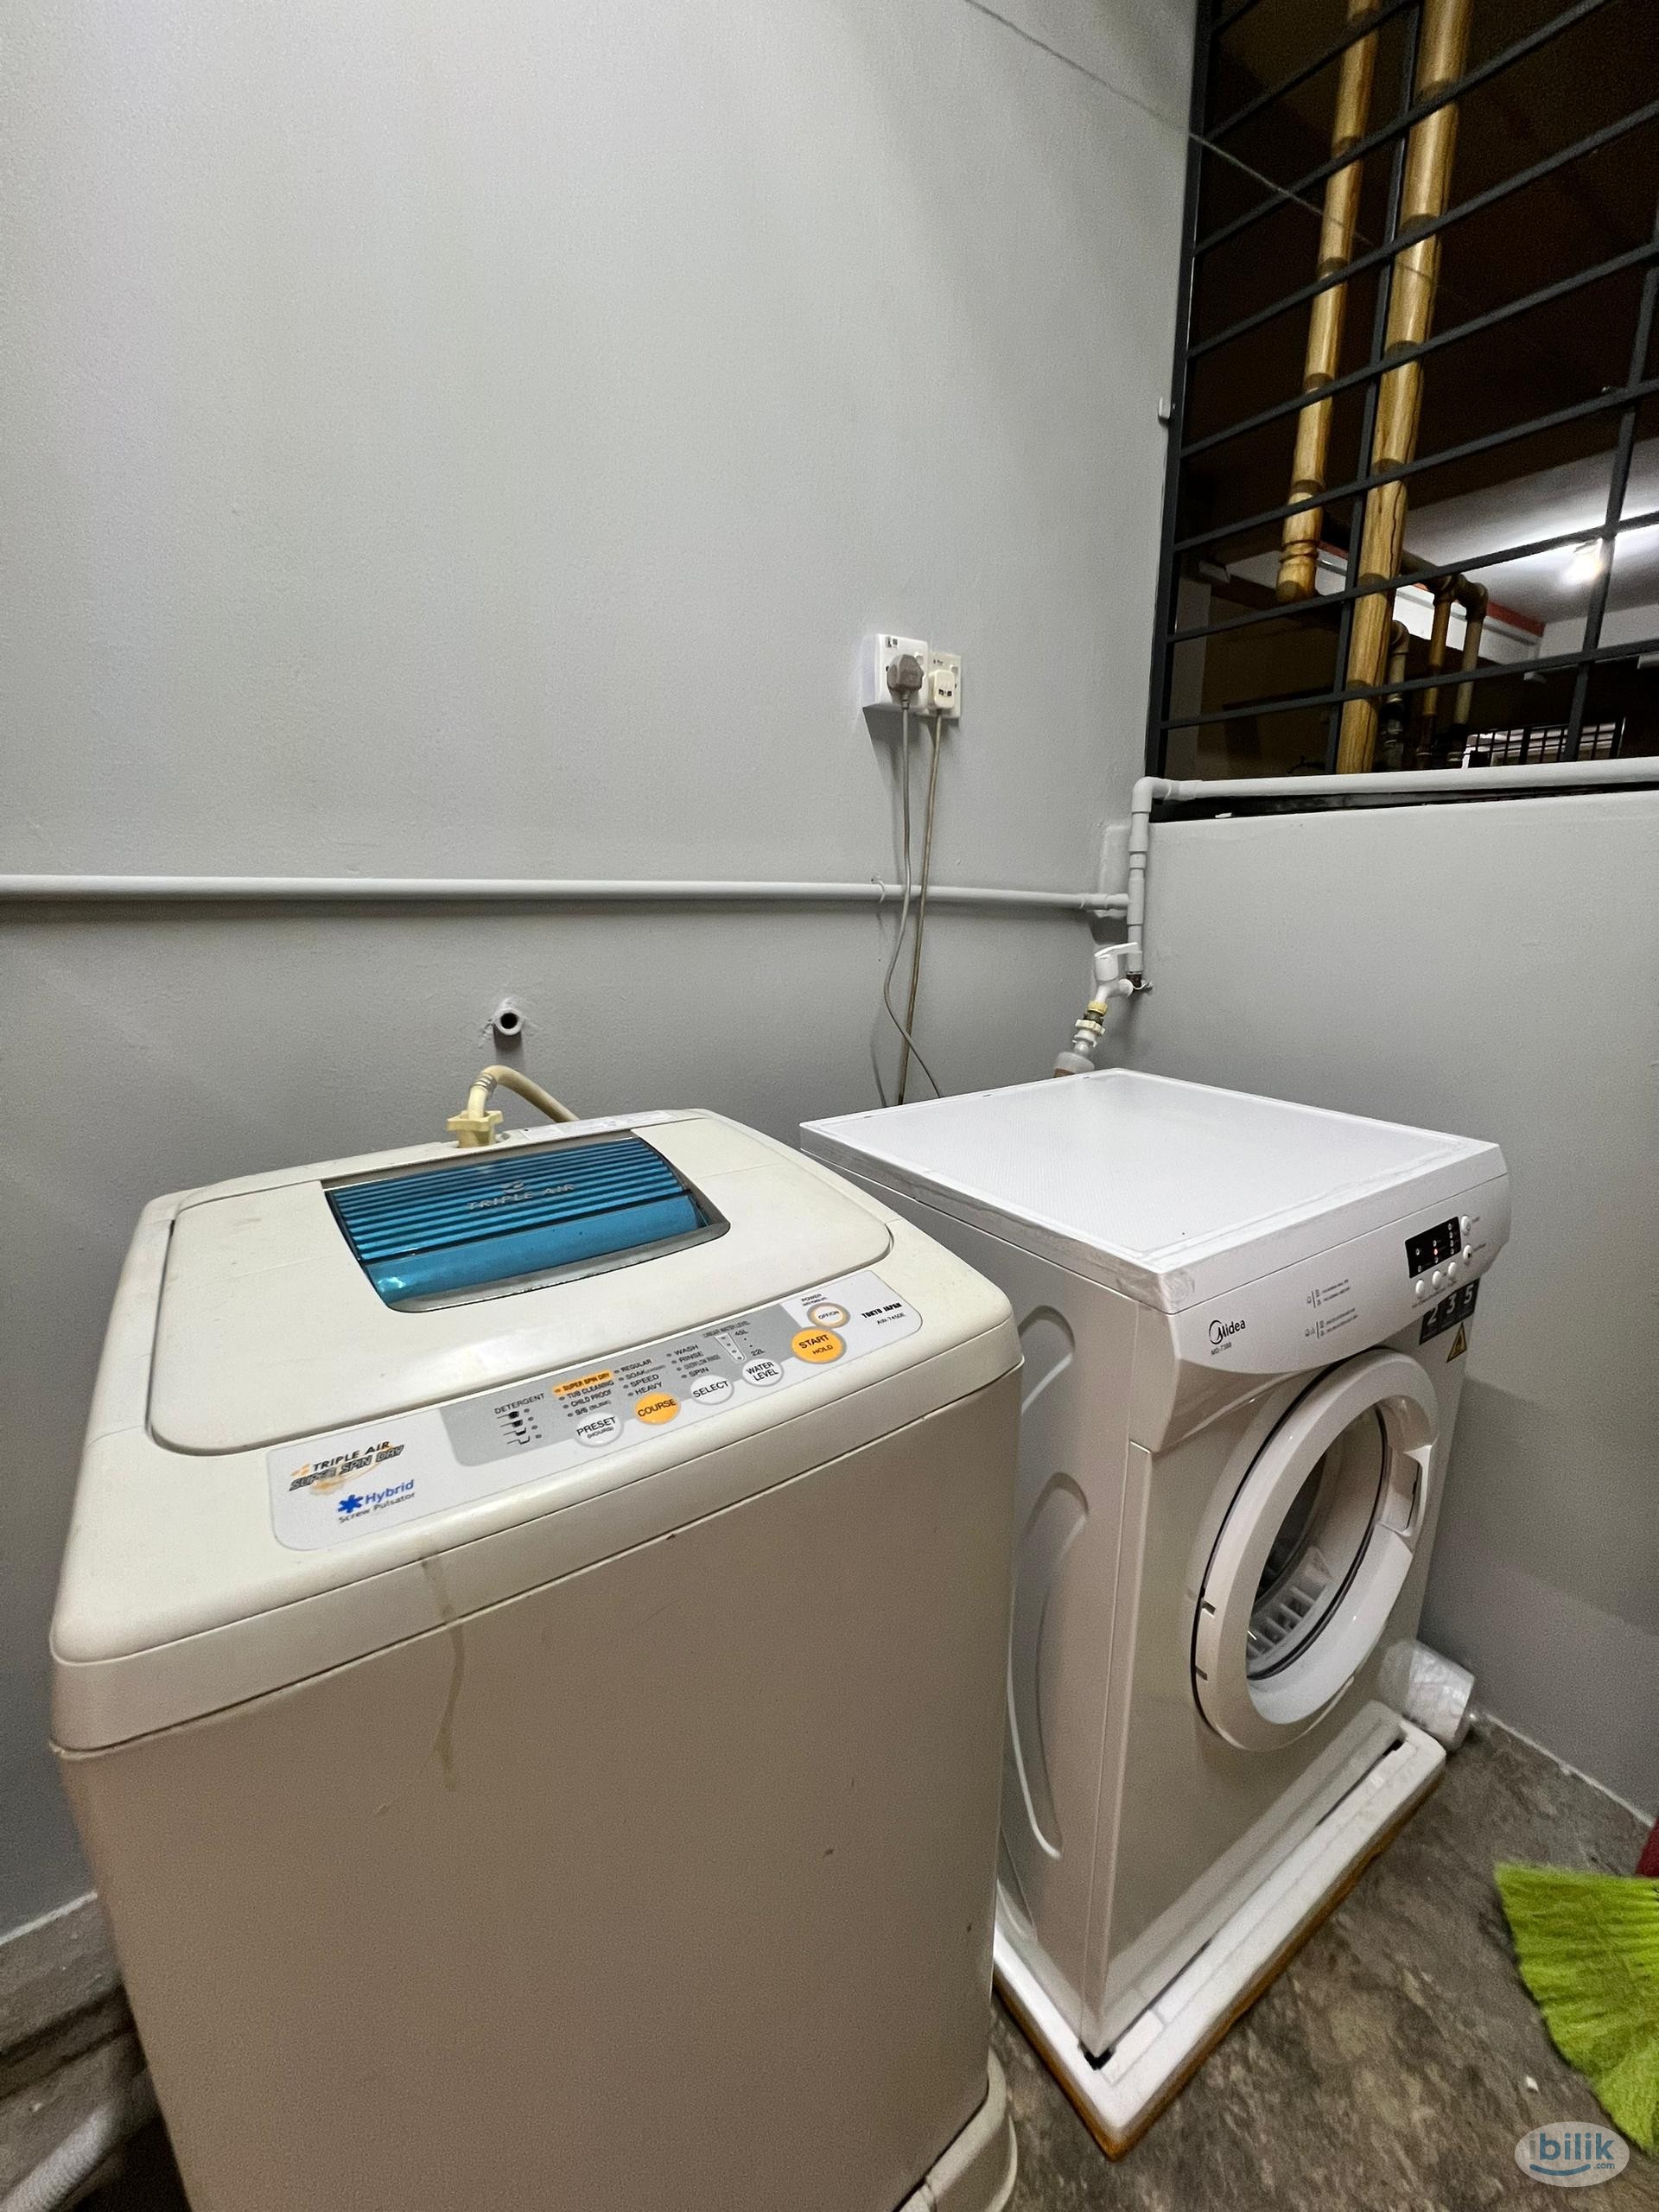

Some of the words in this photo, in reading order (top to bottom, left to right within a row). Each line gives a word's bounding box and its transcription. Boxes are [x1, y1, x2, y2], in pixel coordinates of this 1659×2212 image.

[467, 1192, 533, 1210] TRIPLE
[543, 1183, 575, 1195] AIR
[861, 1308, 882, 1319] TOKYO
[883, 1302, 903, 1313] JAPAN
[1209, 1319, 1246, 1344] Midea
[674, 1344, 699, 1356] WASH
[798, 1334, 830, 1349] START
[812, 1344, 834, 1355] HOLD
[620, 1358, 652, 1372] REGULAR
[678, 1351, 704, 1363] RINSE
[626, 1370, 645, 1380] SOAK
[689, 1366, 709, 1377] SPIN
[746, 1361, 775, 1375] WATER
[753, 1368, 779, 1382] LEVEL
[563, 1379, 582, 1392] SUPER
[583, 1375, 598, 1385] SPIN
[598, 1371, 611, 1382] DRY
[567, 1389, 581, 1399] TUB
[582, 1380, 614, 1395] CLEANING
[630, 1374, 659, 1387] SPEED
[635, 1382, 662, 1395] HEAVY
[692, 1380, 730, 1398] SELECT
[494, 1393, 545, 1414] DETERGENT
[570, 1395, 590, 1408] CHILD
[590, 1389, 612, 1402] PROOF
[637, 1398, 677, 1418] COURSE
[576, 1415, 617, 1437] PRESET
[313, 1452, 359, 1471] TRIPLE
[366, 1441, 391, 1454] AIR
[340, 1455, 372, 1476] SPIN
[375, 1445, 404, 1464] DRY
[365, 1479, 416, 1506] Hybrid
[339, 1508, 371, 1523] Screw
[374, 1492, 416, 1512] Pulsator
